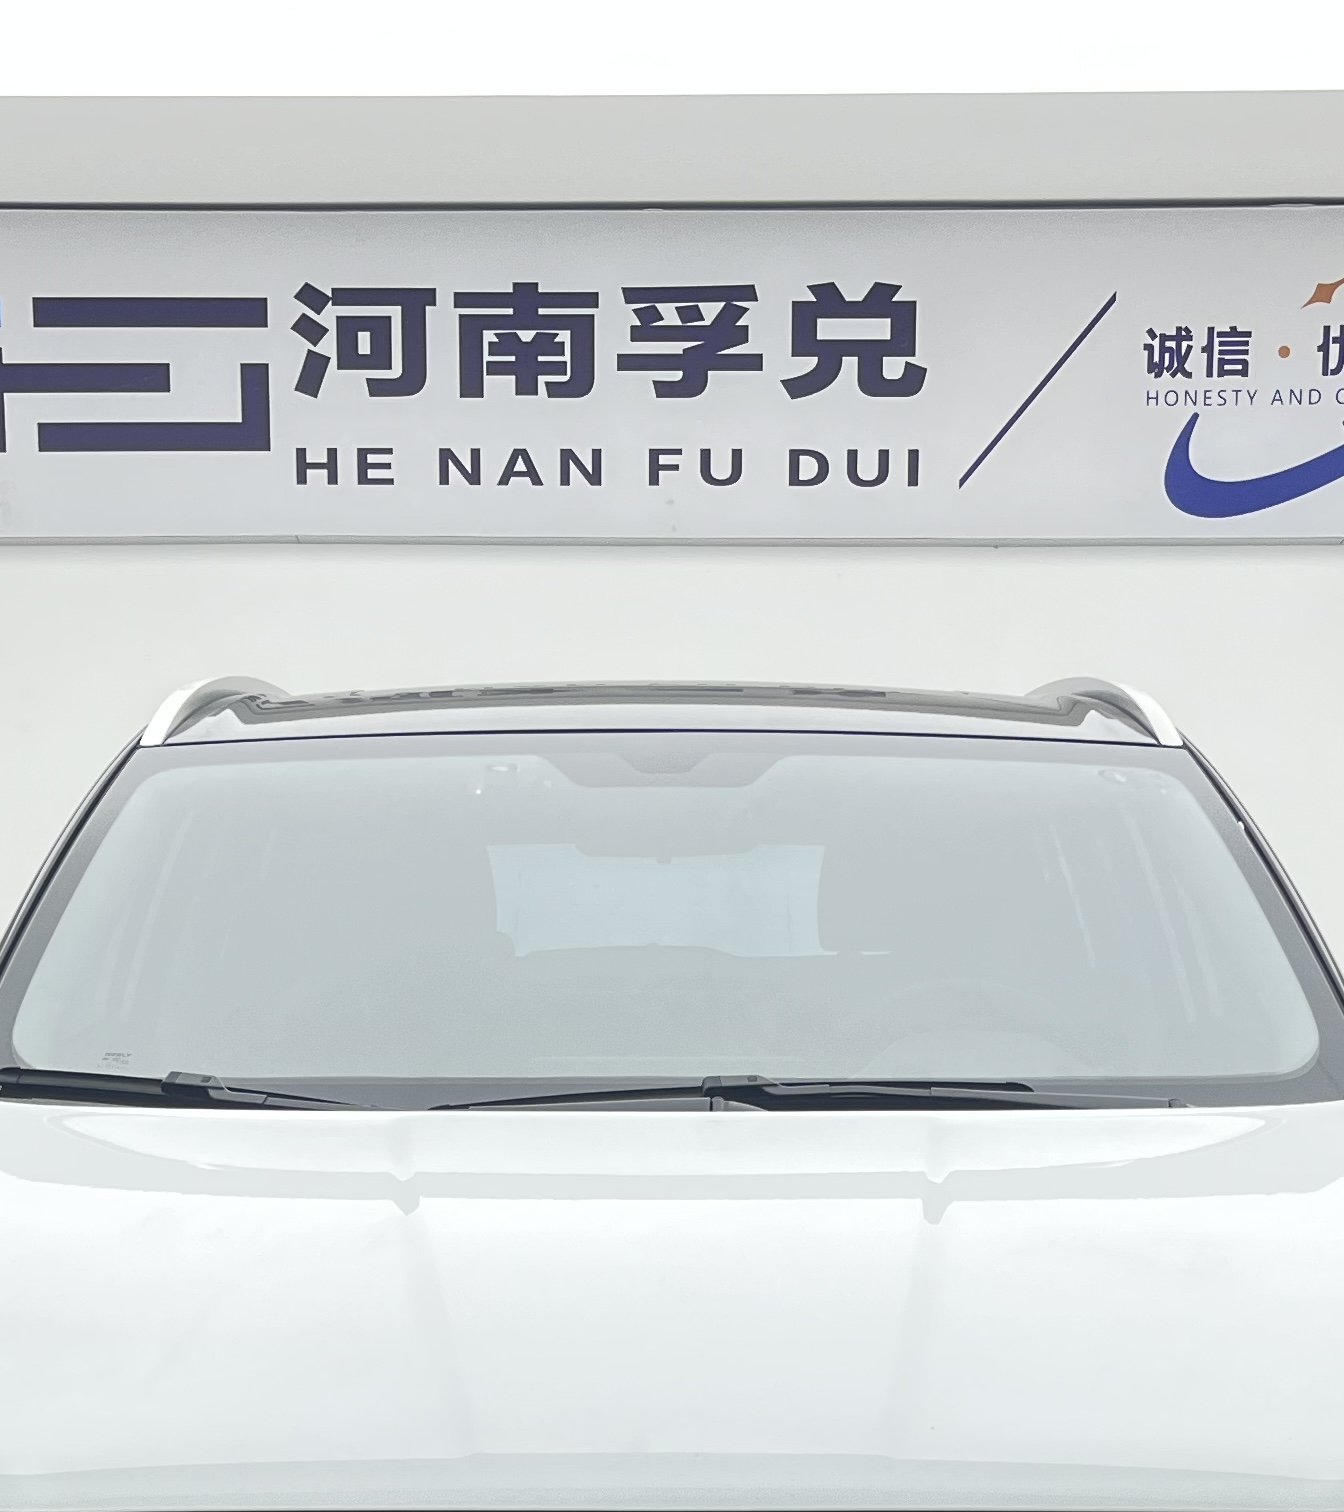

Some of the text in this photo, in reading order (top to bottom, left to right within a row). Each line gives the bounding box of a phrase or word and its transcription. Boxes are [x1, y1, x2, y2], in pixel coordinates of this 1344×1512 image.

[290, 281, 928, 400] 河南孚兑
[1146, 389, 1258, 407] HONESTY
[1270, 388, 1322, 406] AND
[295, 447, 920, 488] HE NAN FU DUI
